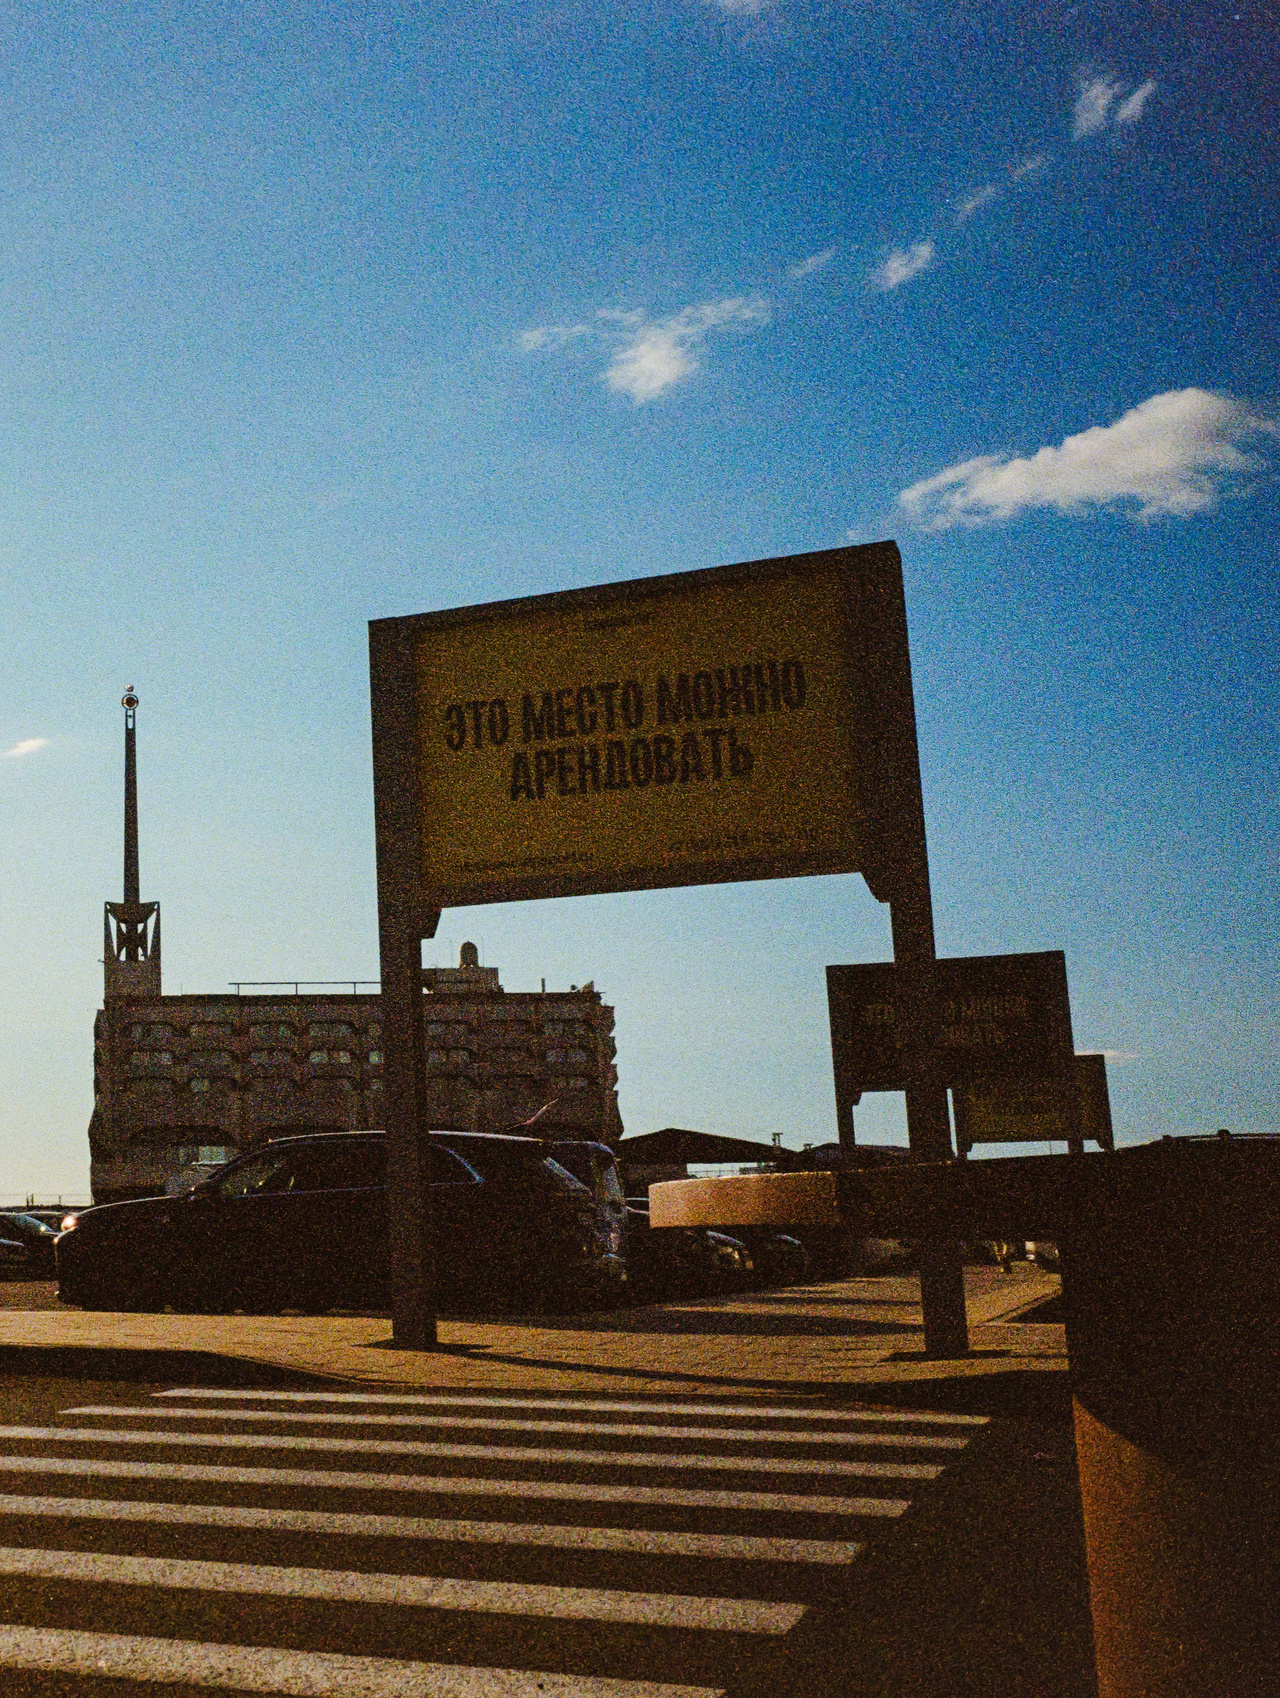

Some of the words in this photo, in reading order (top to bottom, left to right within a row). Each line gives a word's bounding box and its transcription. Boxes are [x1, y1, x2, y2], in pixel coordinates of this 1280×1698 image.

[444, 700, 510, 752] ЭТО
[521, 679, 645, 744] МЕСТО
[656, 657, 808, 724] МОЖНО
[509, 726, 755, 801] АРЕНДОВАТЬ
